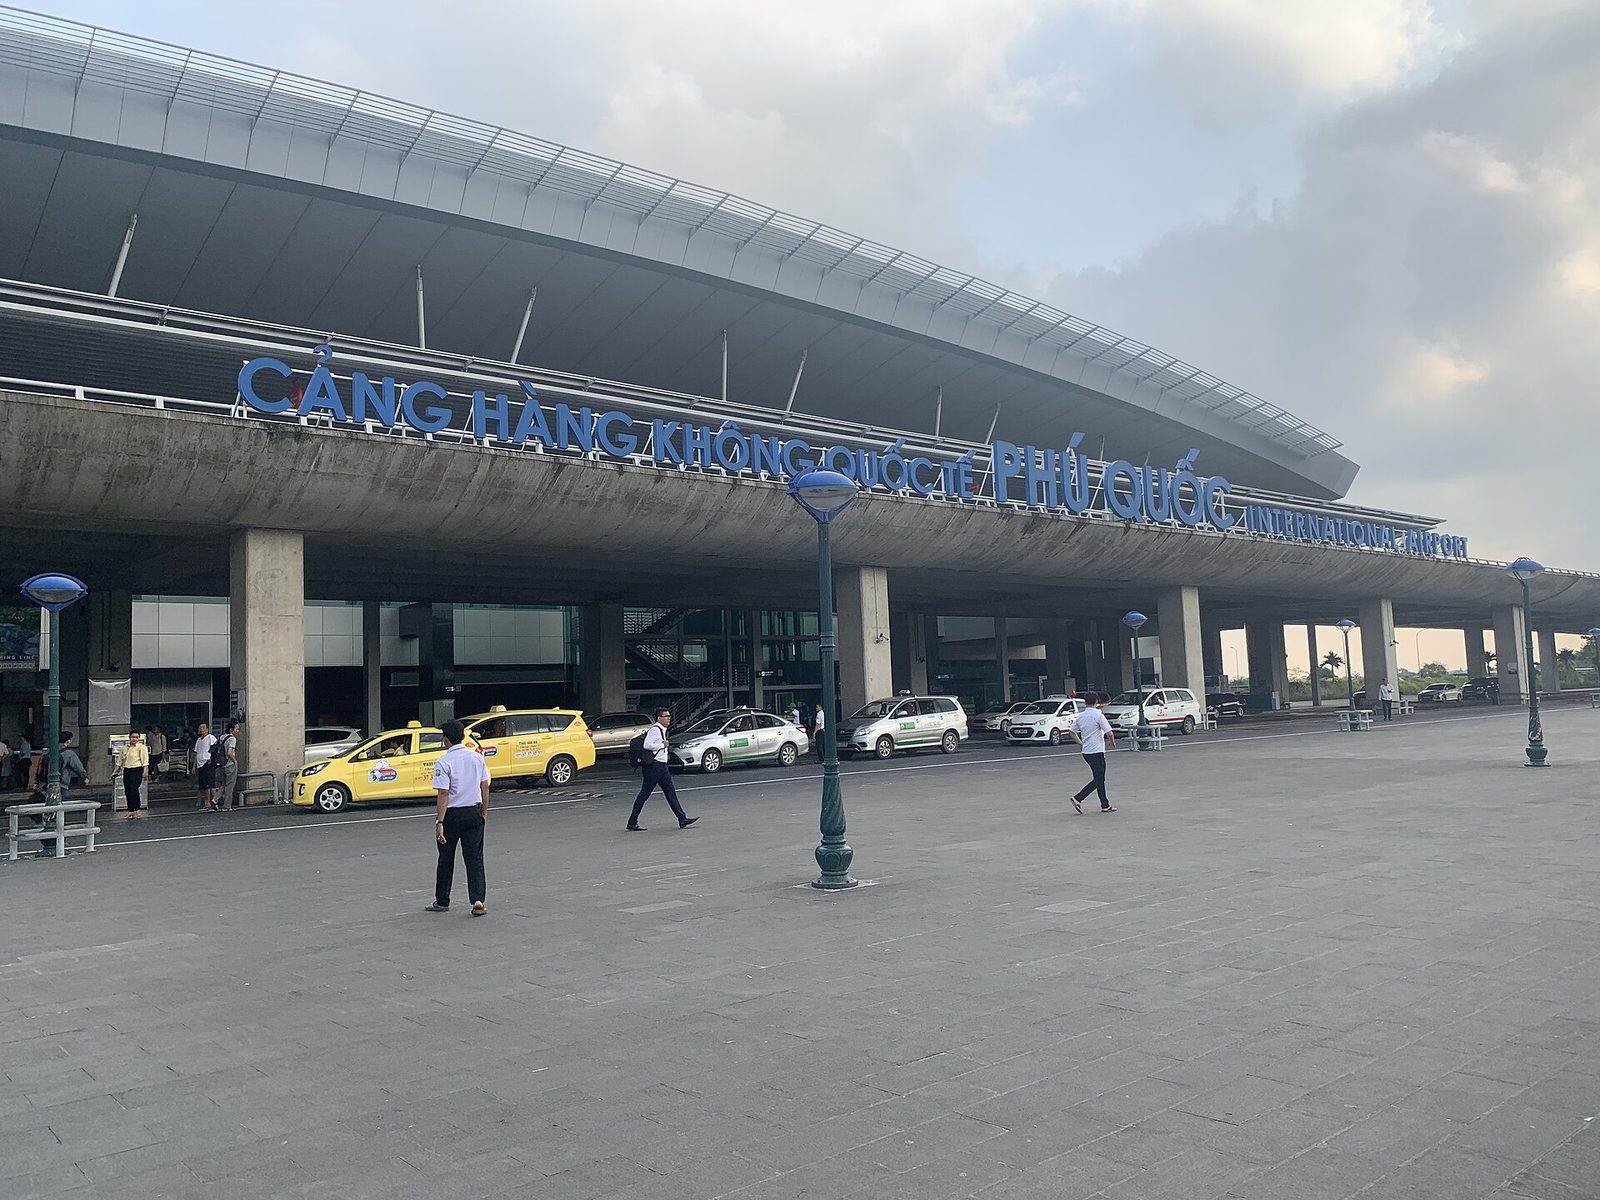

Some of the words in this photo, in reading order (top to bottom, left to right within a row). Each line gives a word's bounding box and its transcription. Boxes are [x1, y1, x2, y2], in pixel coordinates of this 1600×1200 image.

[238, 344, 453, 433] CẢNG
[472, 380, 638, 457] HÀNG
[653, 419, 815, 477] KHÔNG
[825, 437, 934, 494] QUỐC
[940, 448, 977, 498] TẾ
[993, 432, 1089, 513] PHÚ
[1103, 448, 1235, 530] QUỐC
[1246, 505, 1399, 549] INTERNATIONAL
[1404, 529, 1468, 559] AIRPORT
